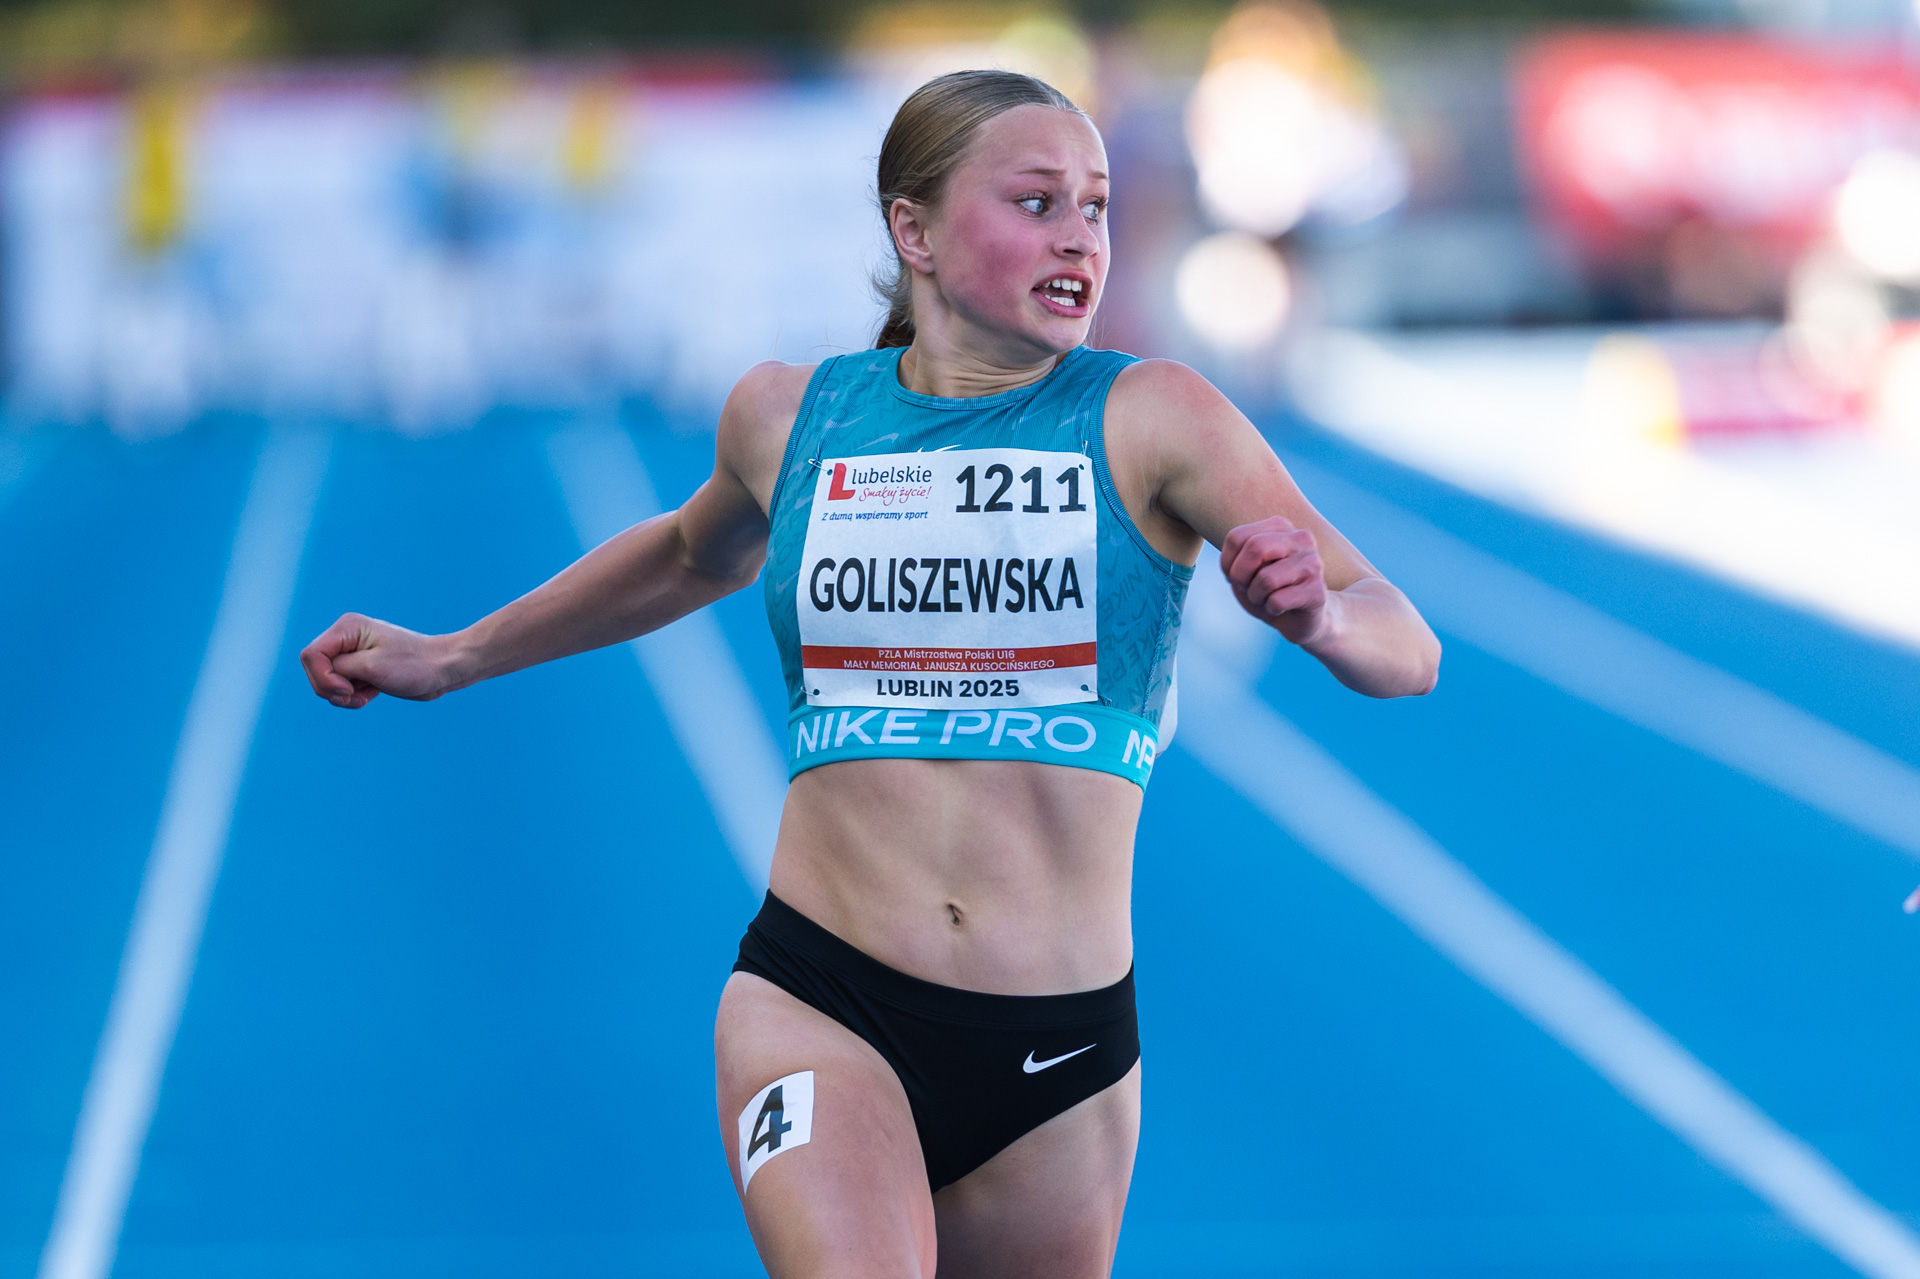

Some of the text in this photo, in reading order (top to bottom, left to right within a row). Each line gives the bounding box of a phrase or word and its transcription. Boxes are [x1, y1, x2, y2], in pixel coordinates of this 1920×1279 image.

[852, 465, 932, 485] lubelskie
[859, 486, 932, 506] Smakuj życie!
[955, 464, 1087, 513] 1211
[821, 511, 928, 522] Z dumą wspieramy sport
[809, 557, 1084, 613] GOLISZEWSKA
[878, 649, 1015, 660] PZLA Mistrzostwa Polski U16
[843, 659, 1055, 671] MAŁY MEMORIAŁ JANUSZA KUSOCIŃSKIEGO
[876, 679, 1020, 698] LUBLIN 2025
[796, 709, 927, 759] NIKE
[939, 709, 1097, 753] PRO
[747, 1084, 793, 1163] 4
